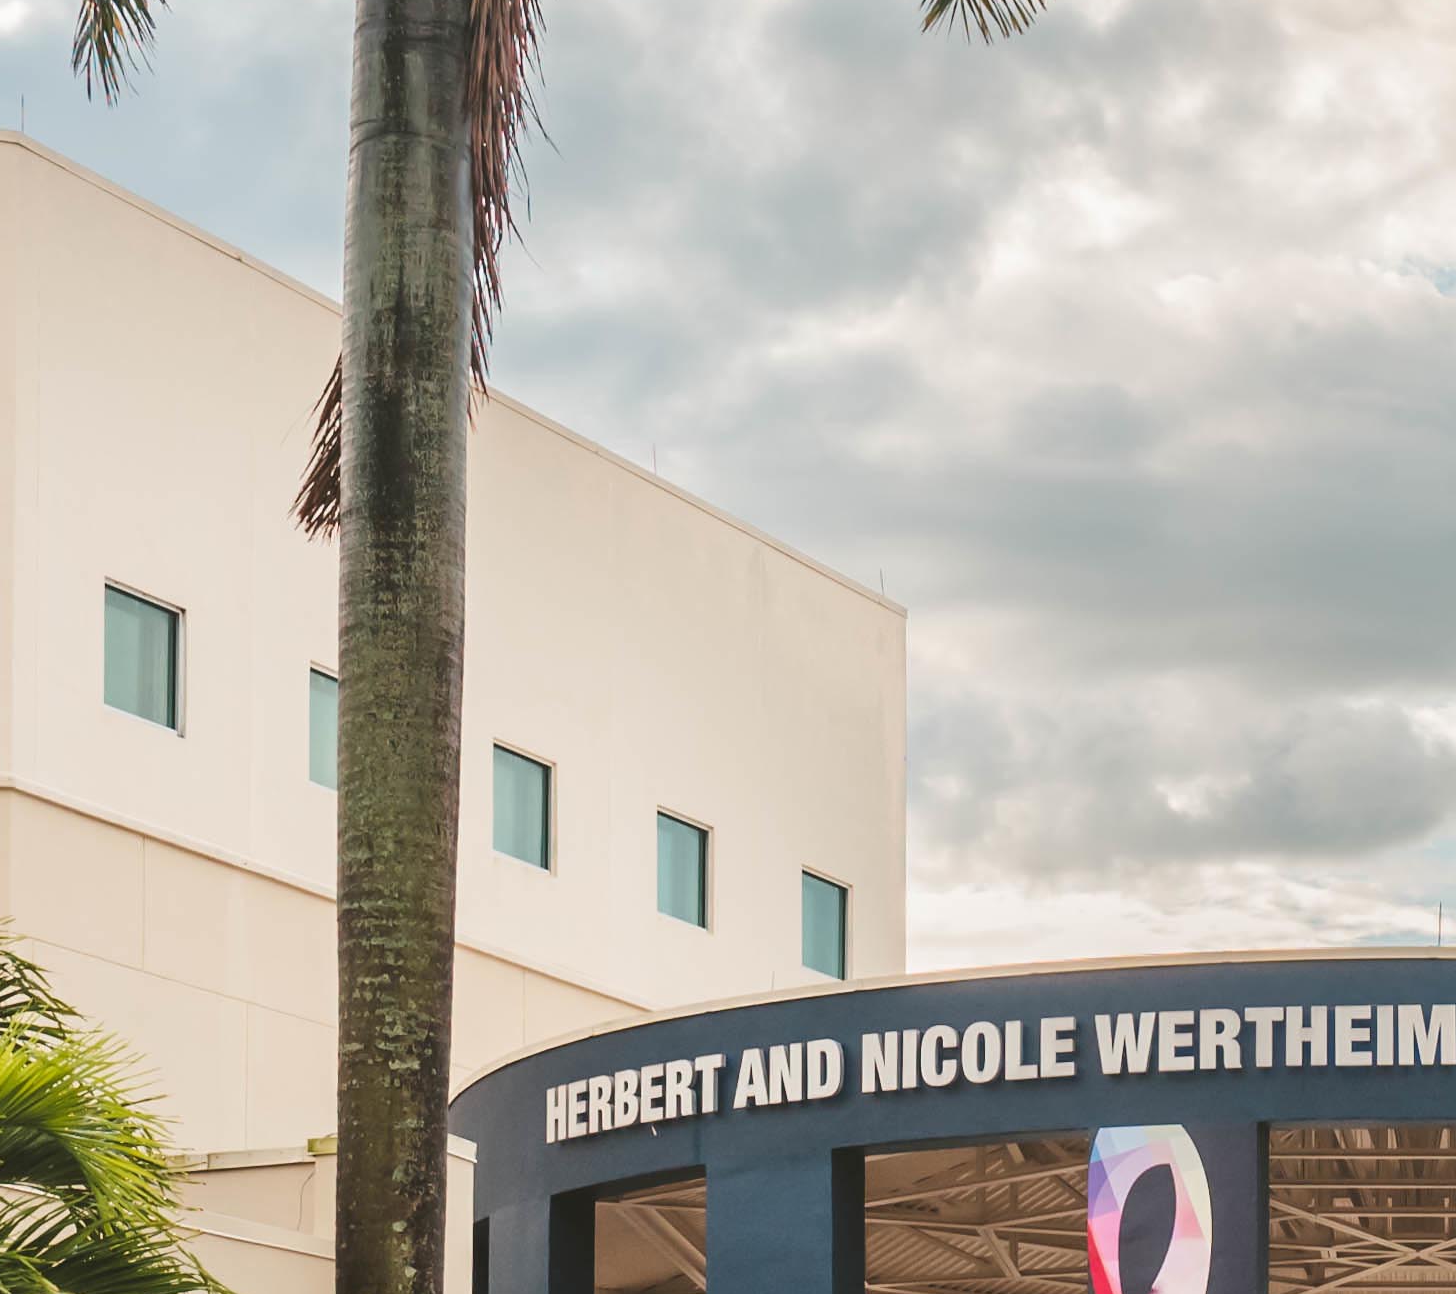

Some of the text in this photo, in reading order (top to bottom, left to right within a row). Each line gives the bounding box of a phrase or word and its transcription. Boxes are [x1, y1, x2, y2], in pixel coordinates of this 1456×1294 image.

[546, 1053, 725, 1144] HERBERT
[733, 1038, 844, 1110] AND
[861, 1016, 1077, 1094] NICOLE
[1095, 1004, 1456, 1075] WERTHEIM
